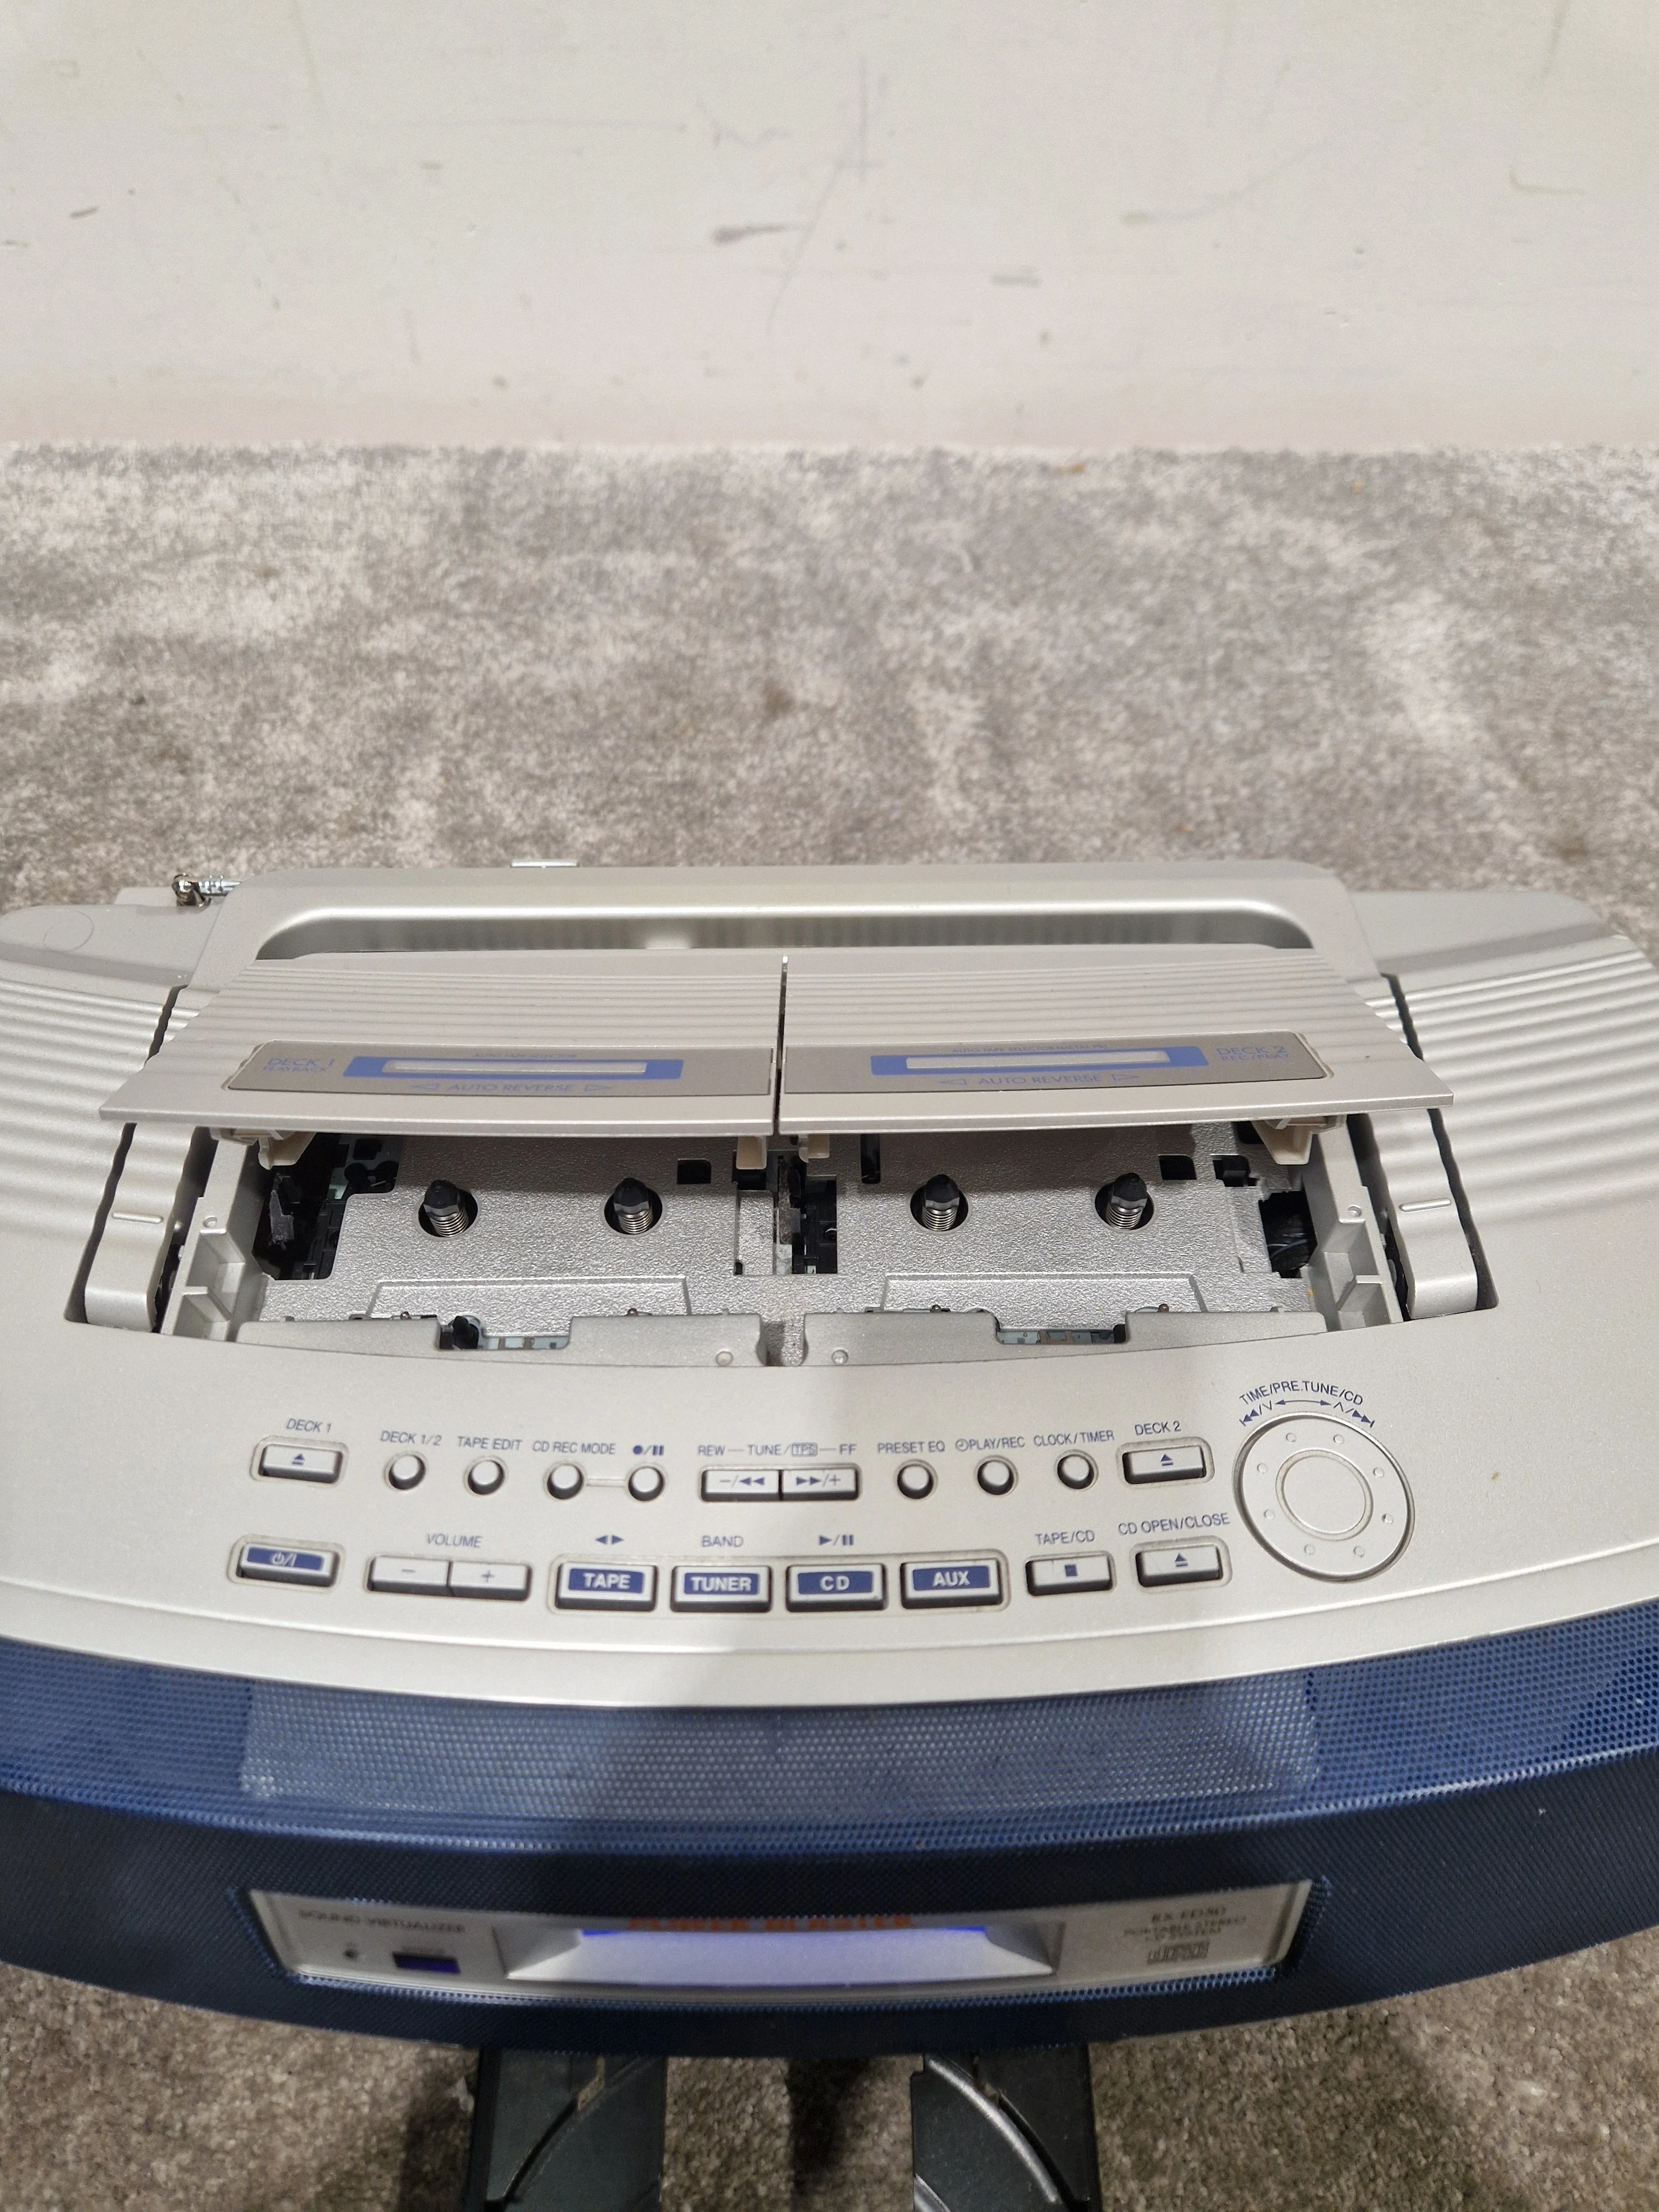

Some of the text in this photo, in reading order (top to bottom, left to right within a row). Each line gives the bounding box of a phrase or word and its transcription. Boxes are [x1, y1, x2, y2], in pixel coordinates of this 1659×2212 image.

[1215, 1045, 1287, 1055] DECK 2
[267, 1057, 319, 1066] DECK
[978, 1073, 1103, 1085] AUTO REVERSE
[447, 1083, 574, 1093] AUTO REVERSE
[1239, 1380, 1364, 1406] TIME/PRE.TUNE/CD
[286, 1417, 332, 1434] DECK 1
[1134, 1420, 1182, 1436] DECK 2
[380, 1430, 442, 1447] DECK 1/2
[457, 1436, 523, 1452] TAPE EDIT
[969, 1436, 1026, 1451] PLAY/REC
[1033, 1429, 1115, 1447] CLOCK/TIMER
[533, 1441, 617, 1455] CD REC MODE
[697, 1444, 726, 1456] REW
[839, 1443, 858, 1455] FF
[877, 1439, 946, 1454] PRESET EQ
[1118, 1512, 1230, 1536] CD OPEN/CLOSE
[426, 1532, 482, 1548] VOLUME
[701, 1535, 744, 1548] BAND
[1035, 1530, 1095, 1546] TAPE/CD
[583, 1572, 631, 1590] TAPE
[691, 1575, 752, 1592] TUNER
[820, 1575, 851, 1591] CD
[932, 1570, 971, 1587] AUX
